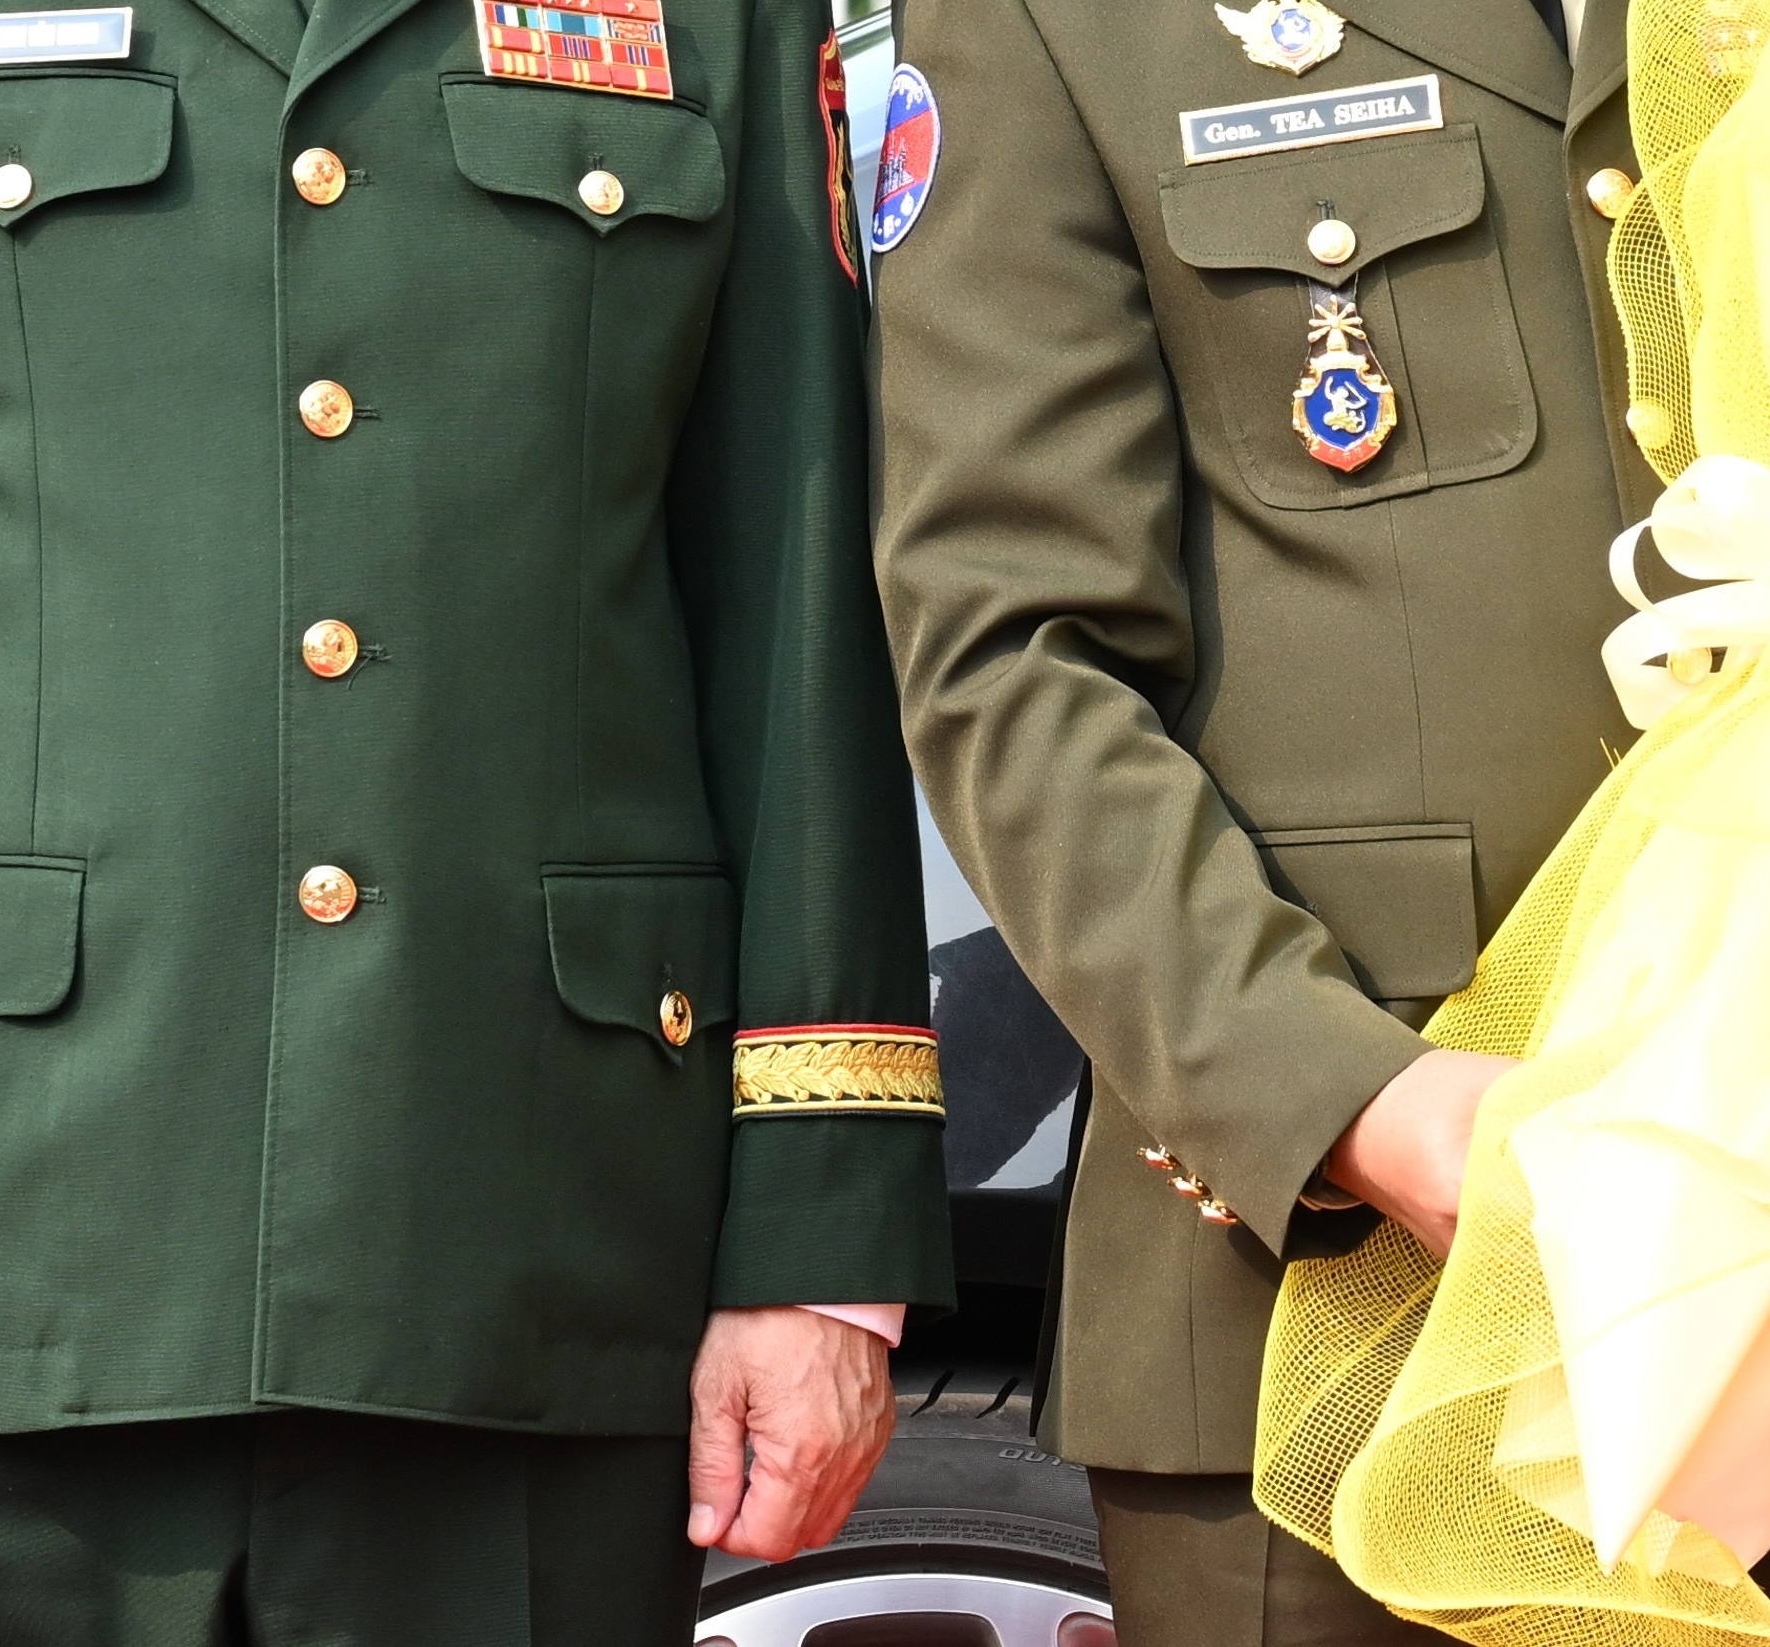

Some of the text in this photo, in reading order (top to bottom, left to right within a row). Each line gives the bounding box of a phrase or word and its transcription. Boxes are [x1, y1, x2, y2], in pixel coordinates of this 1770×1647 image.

[1204, 95, 1416, 144] Gen. TEA SEIHA
